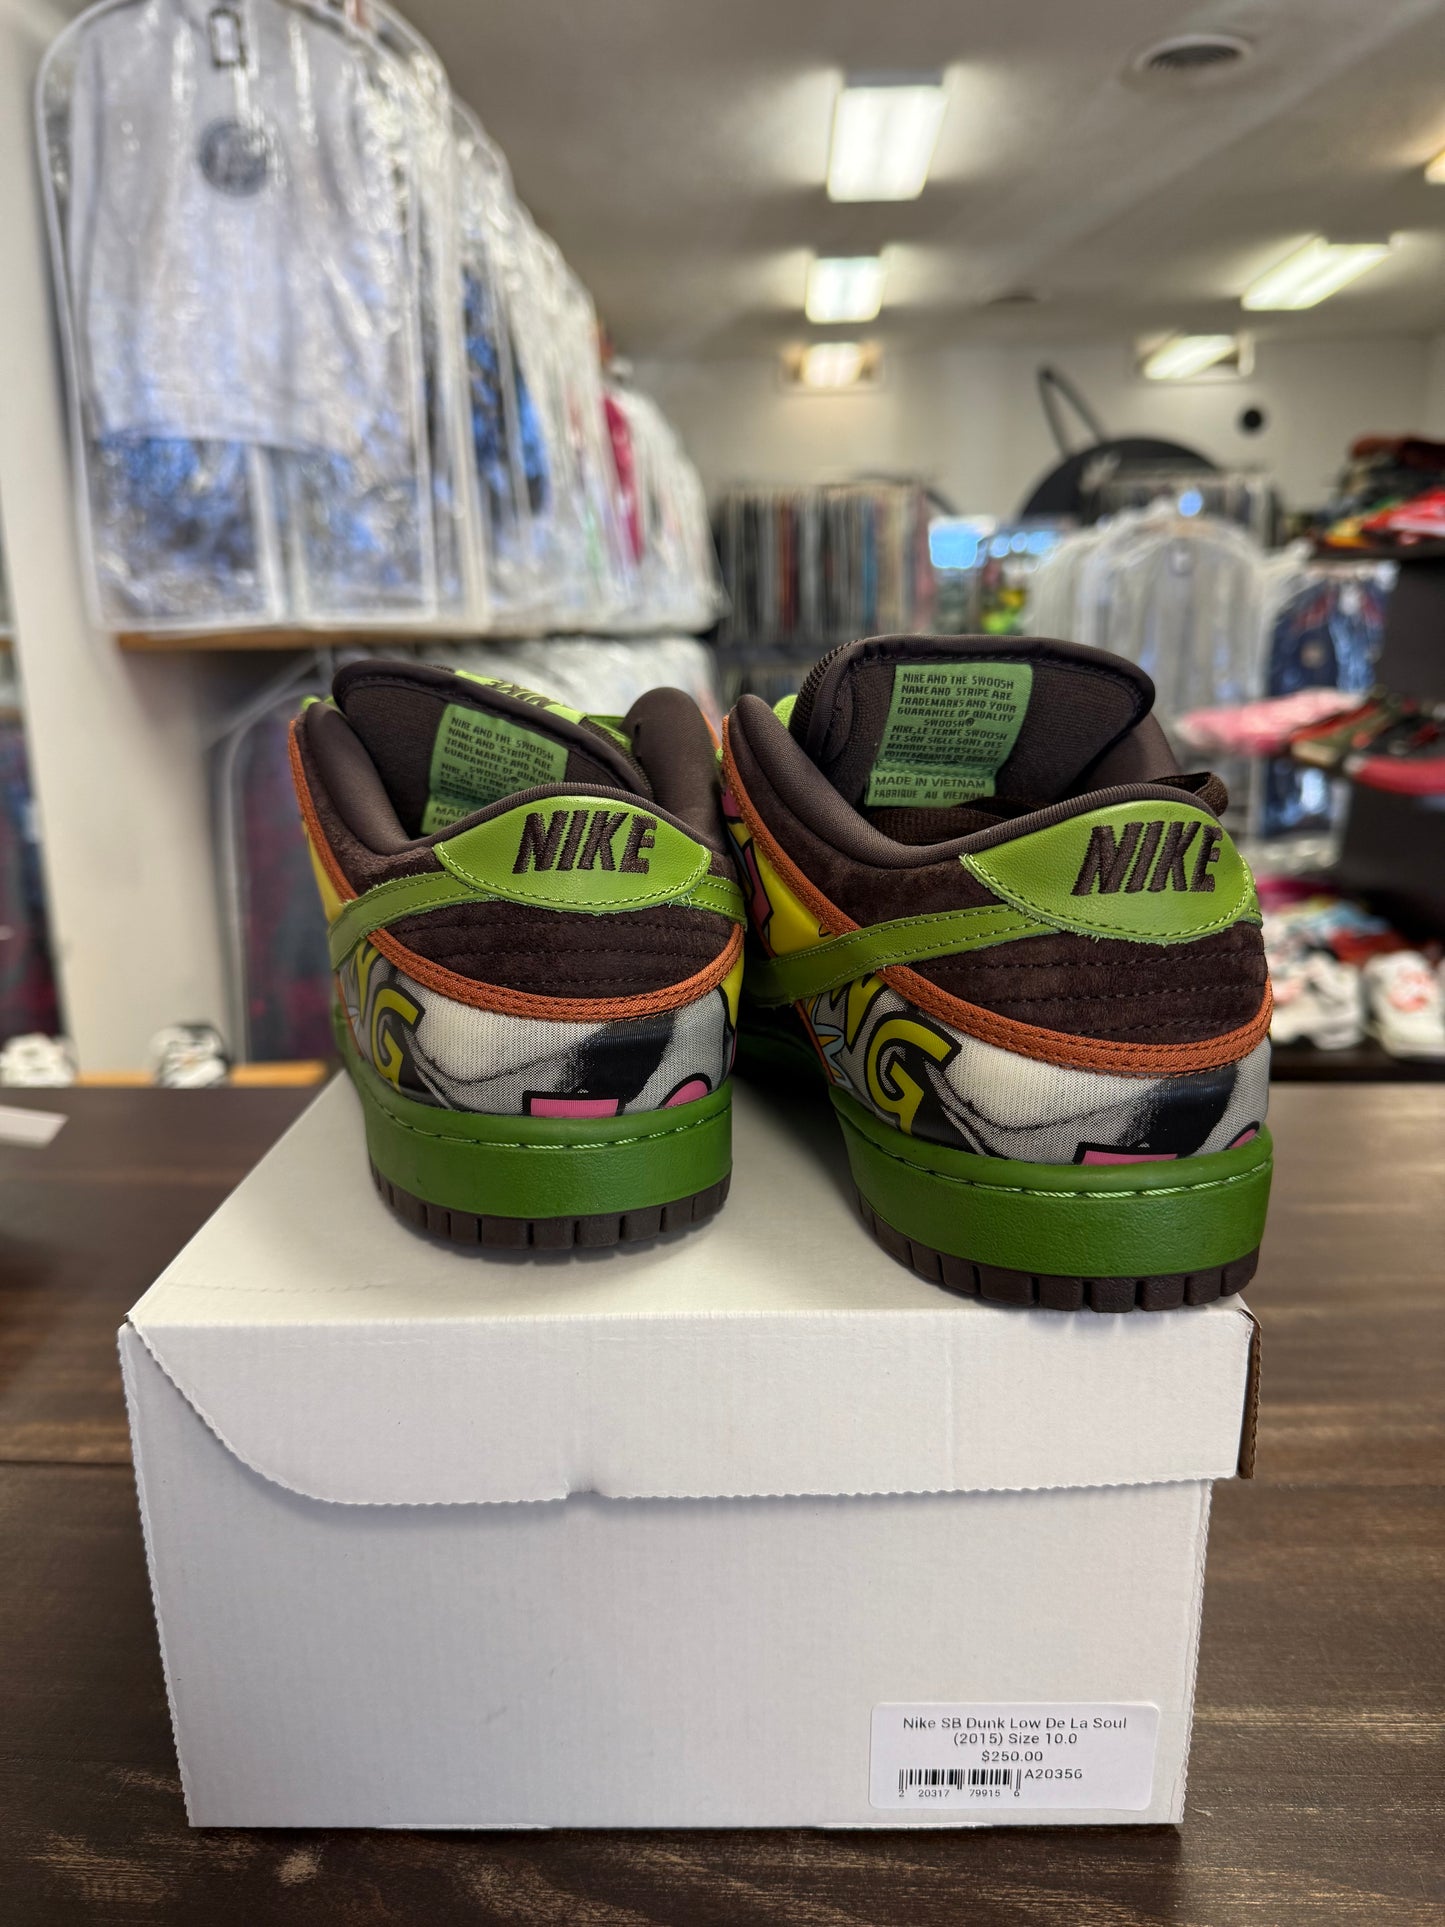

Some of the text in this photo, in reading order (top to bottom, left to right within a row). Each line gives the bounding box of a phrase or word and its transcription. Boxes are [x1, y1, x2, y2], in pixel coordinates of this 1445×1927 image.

[903, 673, 1014, 689] NIKE AND THE SWOOSH
[901, 685, 1013, 700] NAME AND STRIPE ARE
[900, 697, 1017, 713] TRADEMARKS AND YOUR
[897, 707, 1014, 723] GUARANTEE OF QUALITY
[451, 717, 554, 761] NIKE AND THE SWOOSH
[904, 735, 925, 743] SON
[928, 736, 954, 745] SIGLE
[932, 728, 961, 737] TERME
[964, 729, 1008, 741] SWOOSH
[447, 738, 508, 765] TRADEMARKS
[510, 760, 529, 771] AND
[448, 727, 552, 771] NAME AND STRIPE ARE
[444, 746, 499, 771] GUARANTEE
[875, 776, 986, 788] MADE IN VIETNAM
[874, 789, 918, 799] FABRIQUE
[924, 791, 938, 799] AU
[512, 809, 658, 875] NIKE
[1070, 820, 1223, 897] NIKE
[903, 1717, 1127, 1729] Nike SB Dunk Low De La Soul
[953, 1732, 1078, 1746] (2015) Size 10.0
[981, 1750, 1043, 1763] $250.00
[1024, 1768, 1083, 1780] A20356
[898, 1788, 1020, 1797] 2 20317 79915 6
